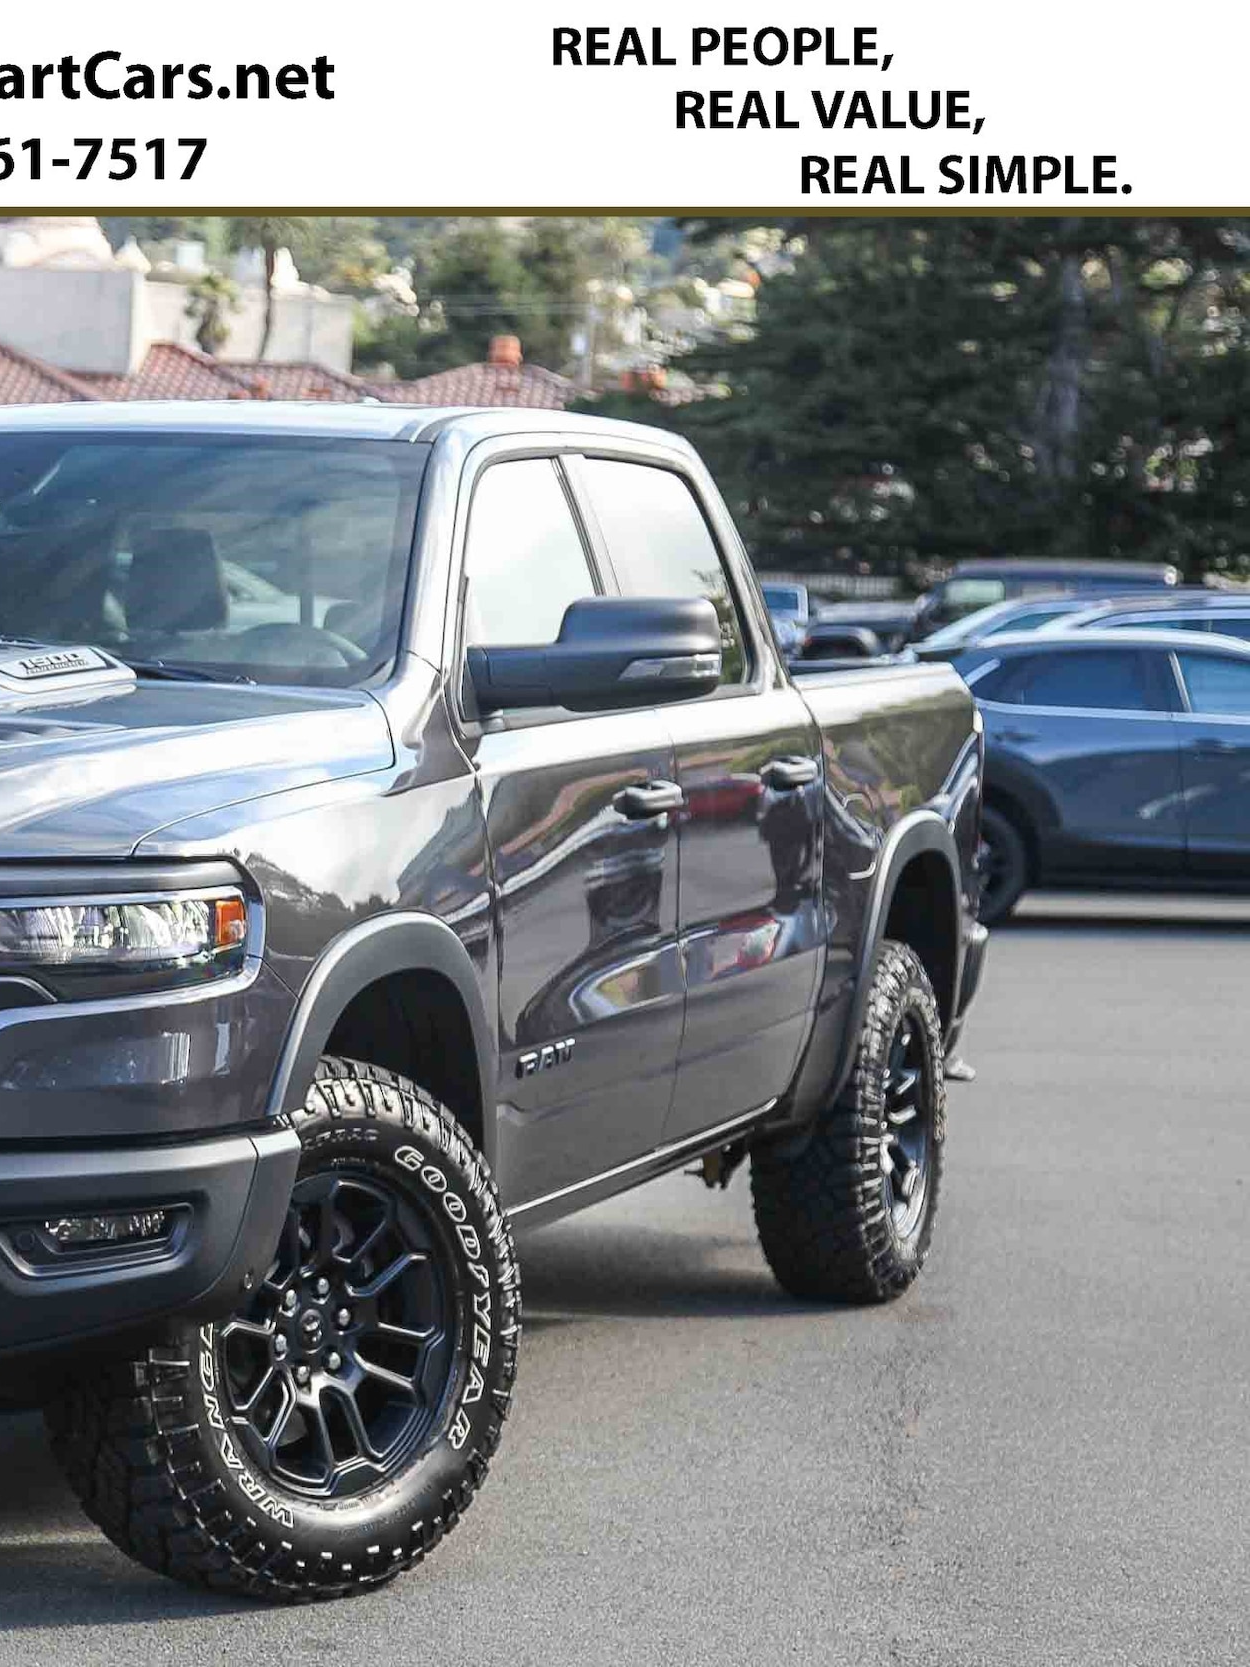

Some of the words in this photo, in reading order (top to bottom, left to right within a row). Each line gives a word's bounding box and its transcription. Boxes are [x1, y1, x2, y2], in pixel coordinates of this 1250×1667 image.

[515, 1038, 576, 1080] RAM
[394, 1145, 496, 1451] GOODYEAR
[200, 1323, 295, 1529] WRANGL
